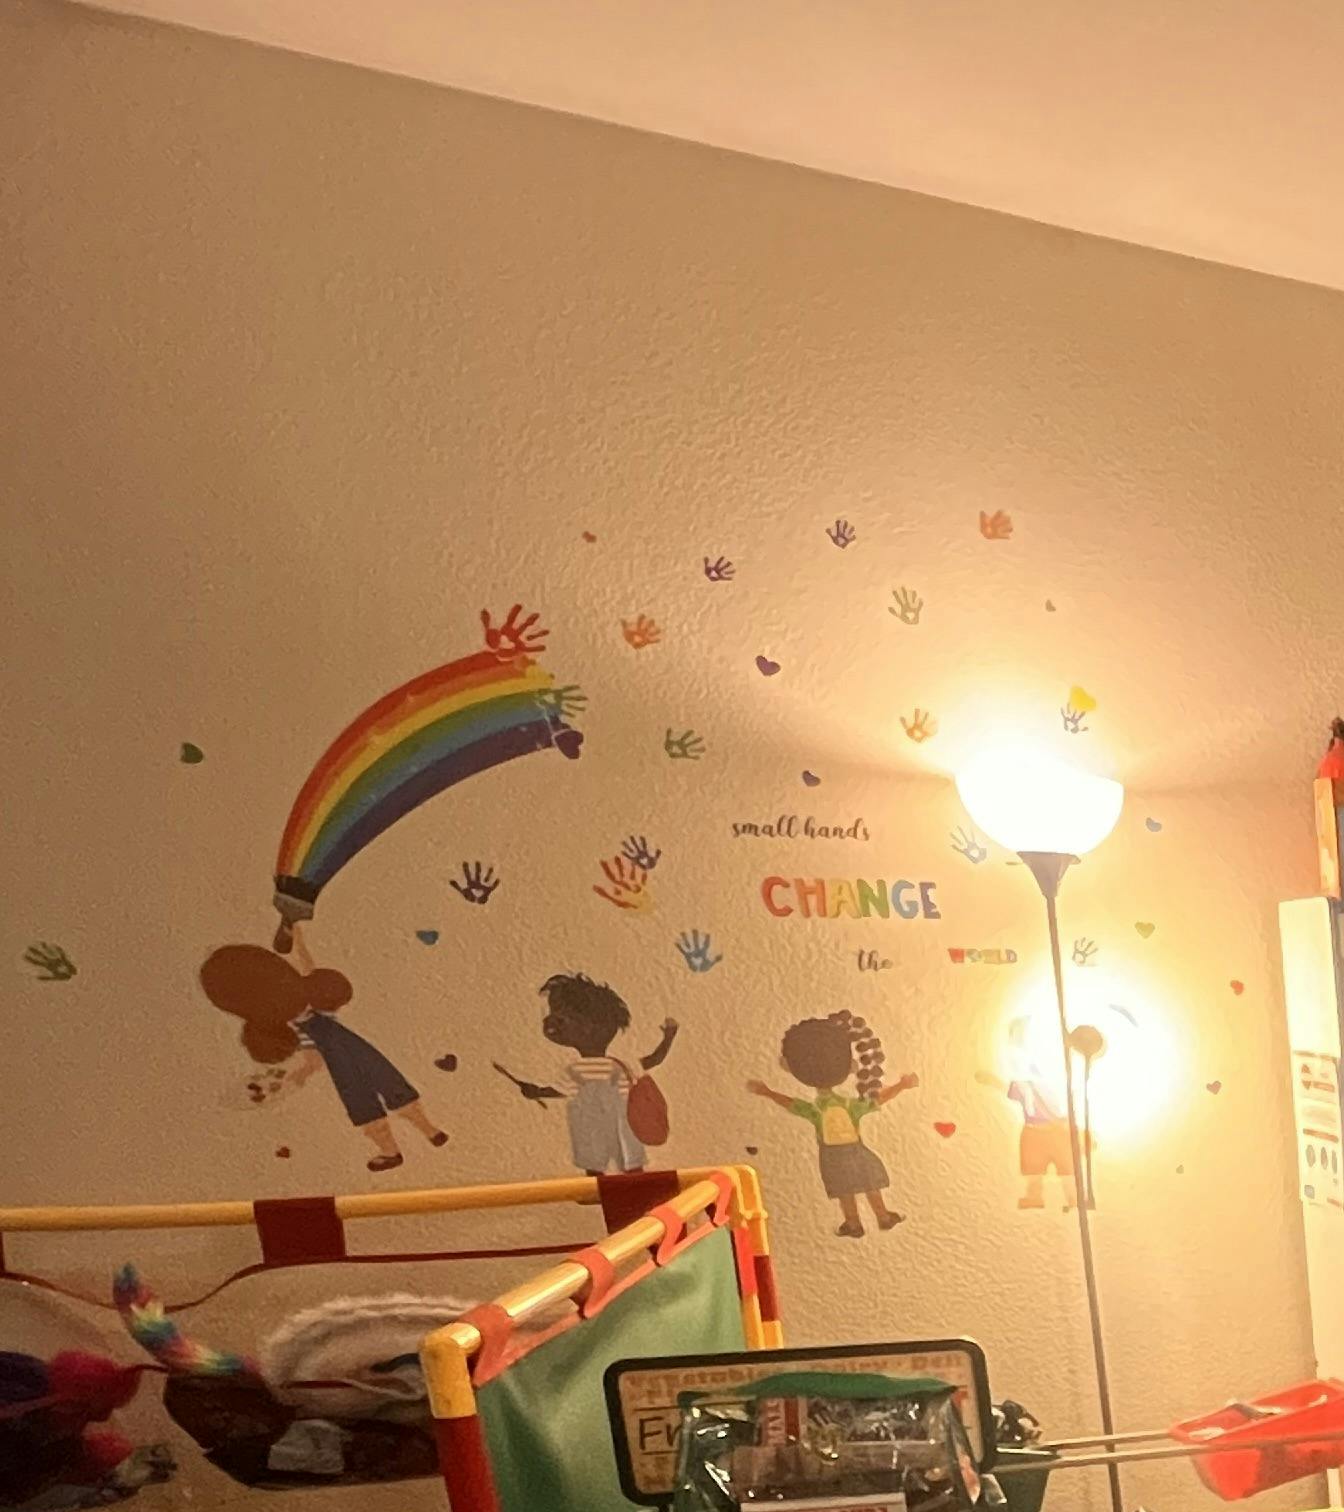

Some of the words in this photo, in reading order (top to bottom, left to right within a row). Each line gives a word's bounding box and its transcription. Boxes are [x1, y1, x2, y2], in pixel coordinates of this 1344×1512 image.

[731, 814, 799, 839] small
[803, 817, 871, 842] hands
[760, 875, 942, 920] CHANGE
[857, 947, 893, 972] the
